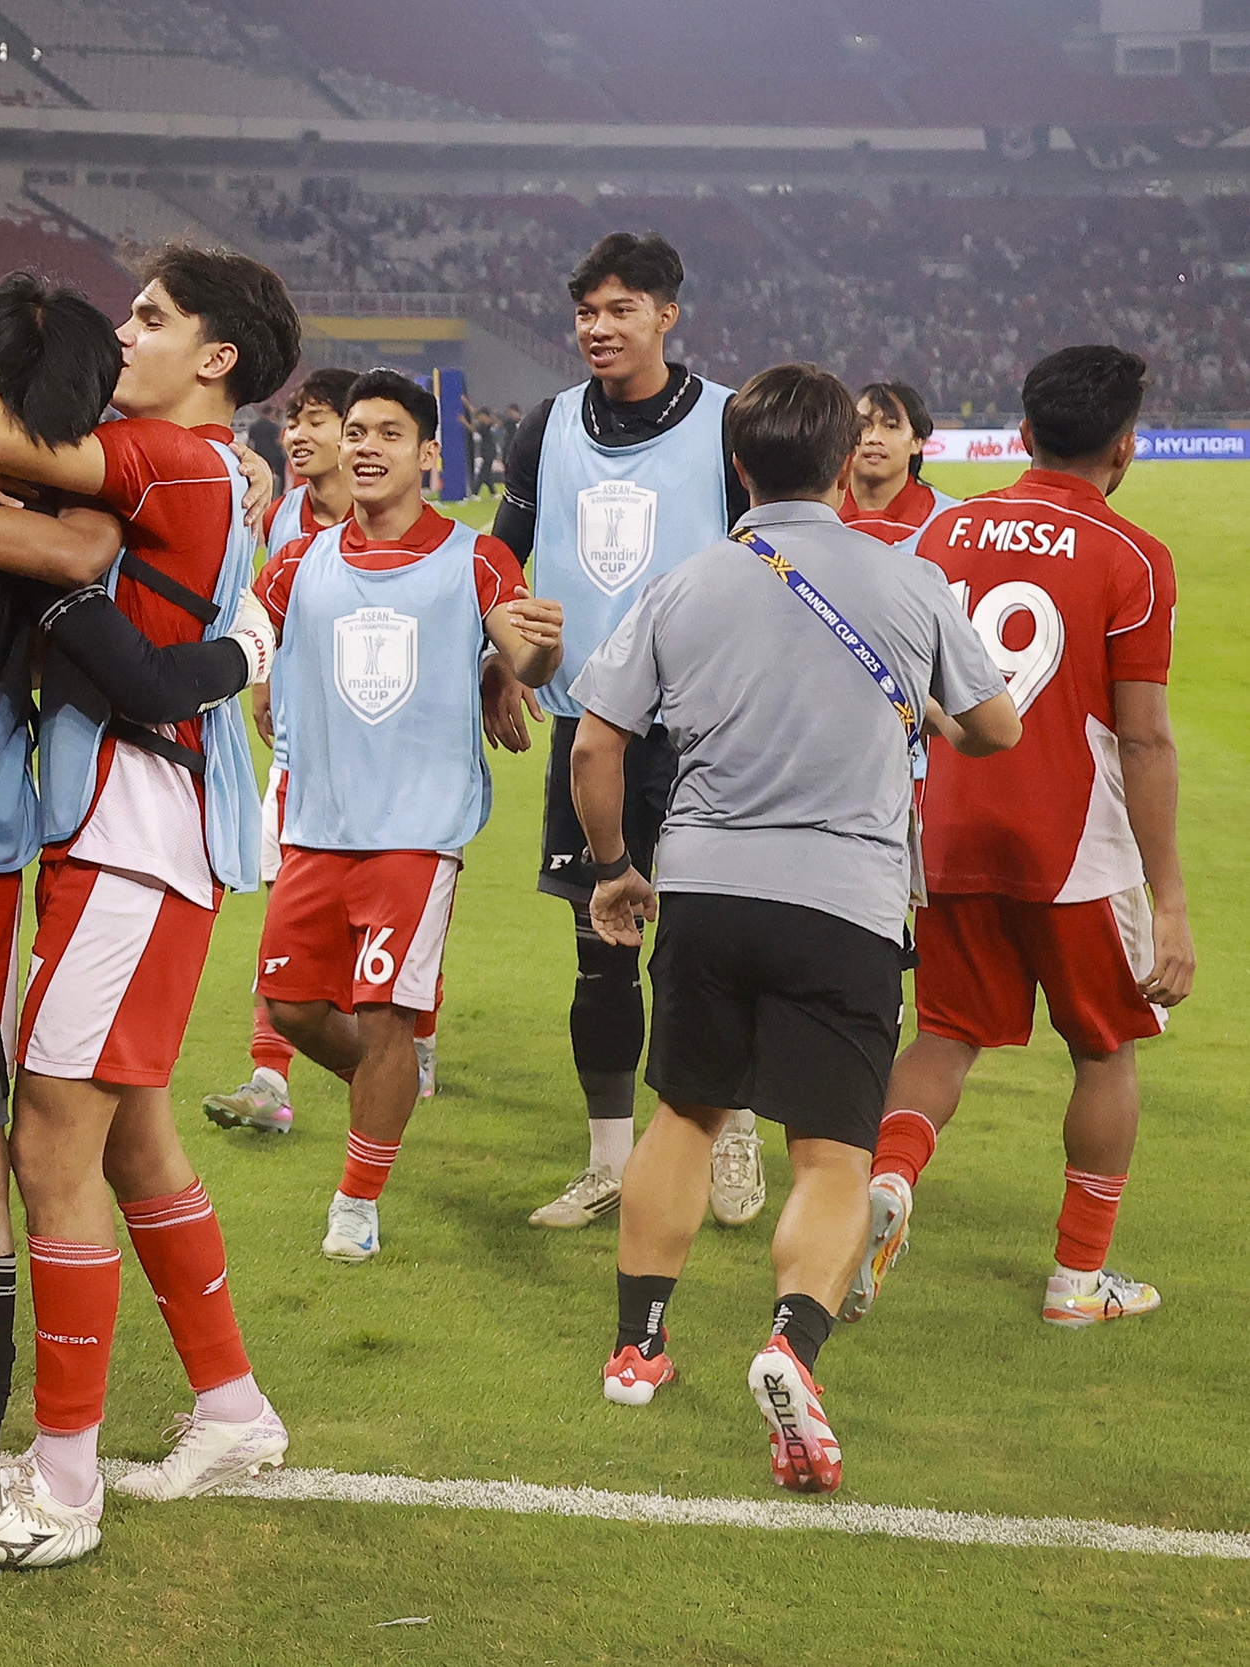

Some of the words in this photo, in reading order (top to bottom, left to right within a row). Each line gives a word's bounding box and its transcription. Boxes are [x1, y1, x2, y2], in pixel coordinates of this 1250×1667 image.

[1155, 436, 1244, 454] HYUNDAI
[602, 484, 630, 495] ASEAN
[948, 517, 972, 549] F.
[977, 519, 1076, 560] MISSA
[590, 548, 638, 561] mandiri
[599, 562, 627, 573] CUP
[360, 611, 390, 622] ASEAN
[794, 582, 840, 627] MANDIRI
[835, 622, 859, 647] CUP
[853, 643, 881, 673] 2025
[348, 675, 401, 689] mandiri
[358, 690, 389, 701] CUP
[354, 926, 395, 985] 16
[37, 1330, 98, 1345] ONESIA
